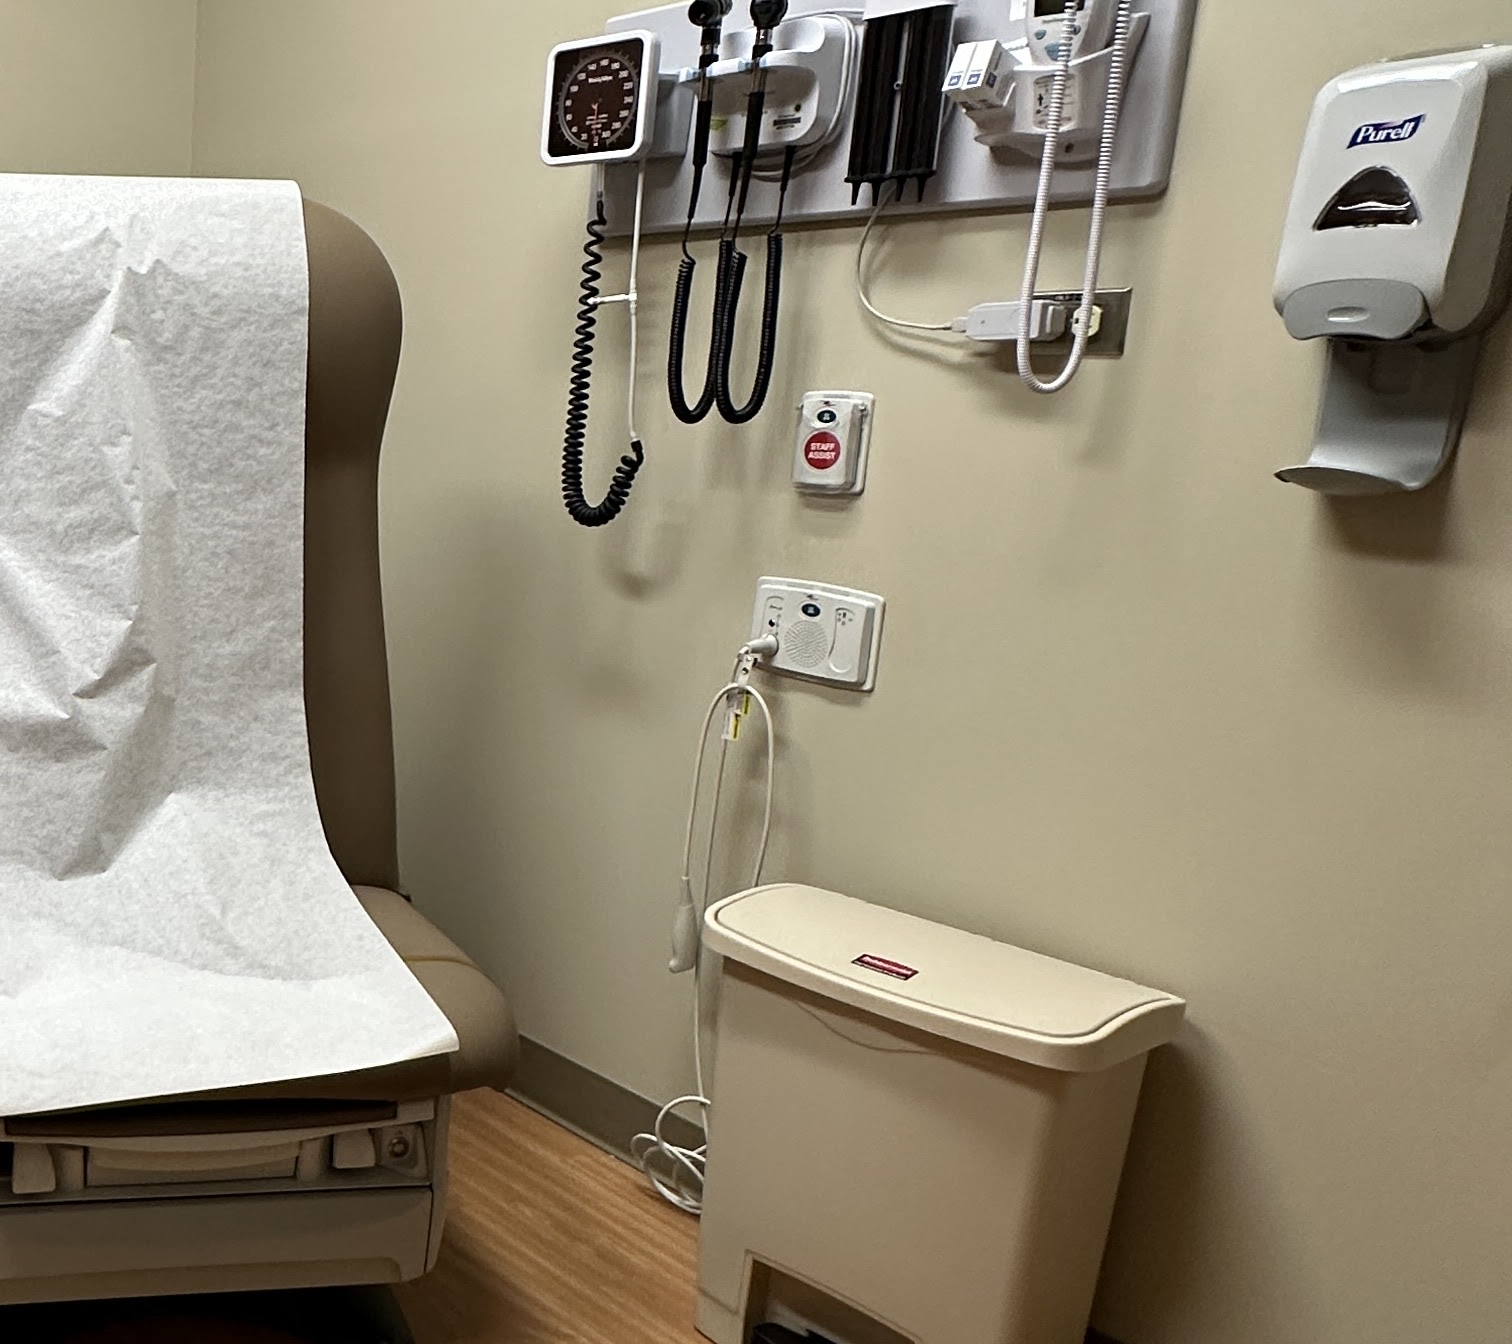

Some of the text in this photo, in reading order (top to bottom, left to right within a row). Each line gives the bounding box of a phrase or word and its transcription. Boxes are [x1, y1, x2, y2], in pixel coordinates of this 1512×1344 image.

[1355, 121, 1416, 143] Purell
[810, 442, 836, 451] STAFF
[808, 451, 837, 460] ASSIST
